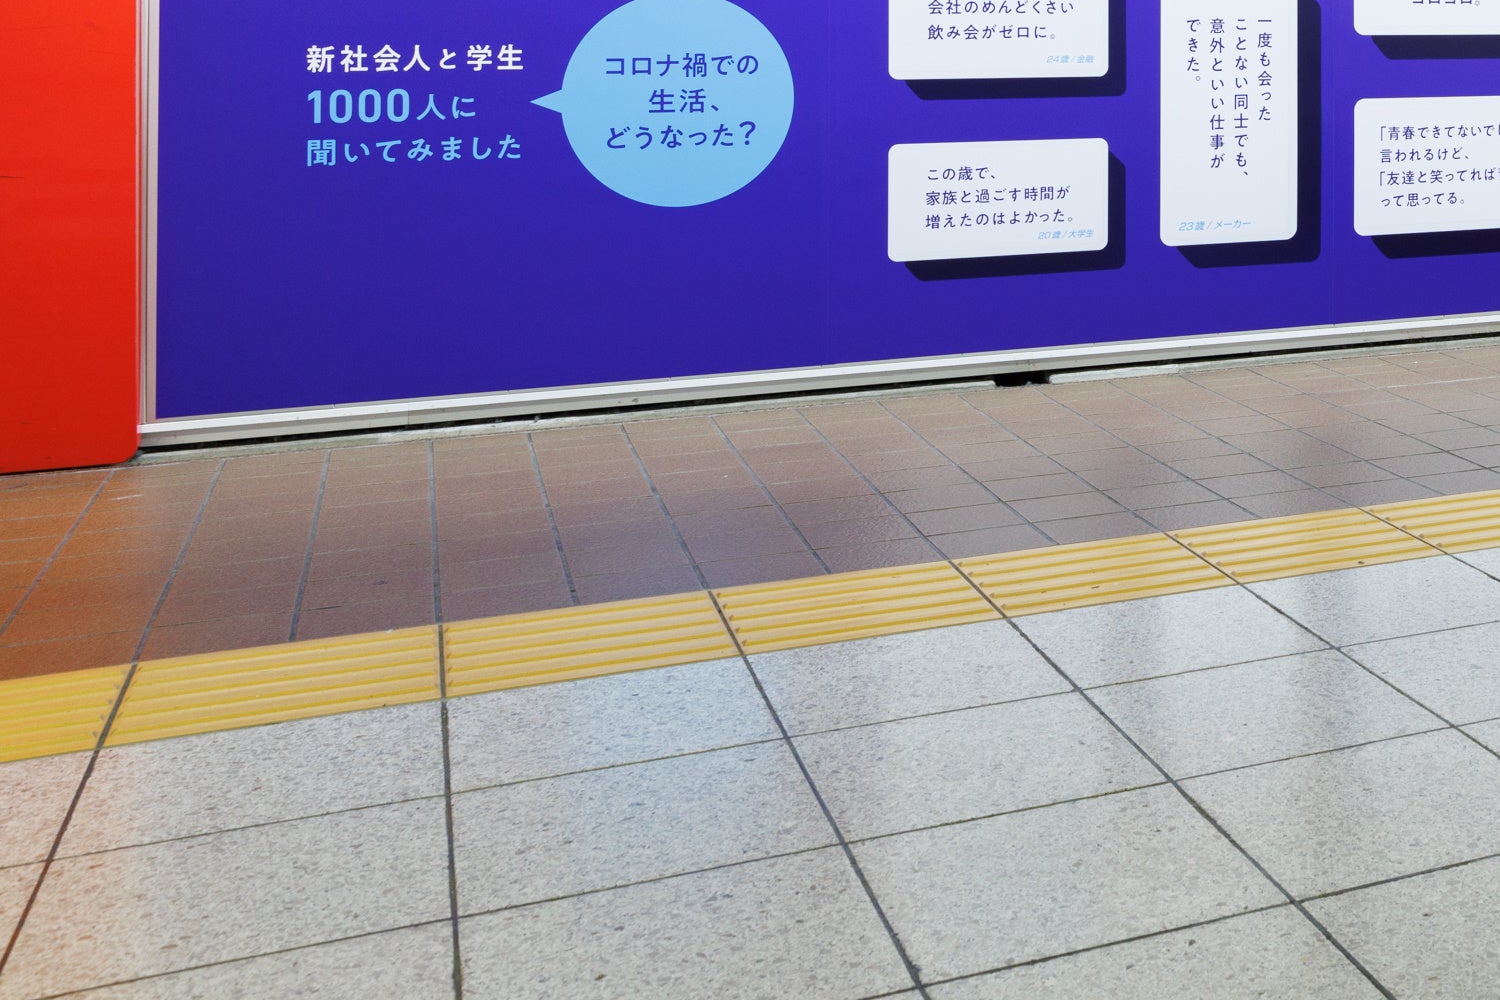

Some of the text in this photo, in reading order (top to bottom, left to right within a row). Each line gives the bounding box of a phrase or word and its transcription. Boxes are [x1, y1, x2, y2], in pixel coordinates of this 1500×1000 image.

[926, 23, 1058, 42] 飲み会がゼロに。
[305, 44, 524, 74] 新社会人と学生
[1185, 17, 1203, 83] できた。
[604, 52, 760, 79] コロナ禍での
[1256, 18, 1273, 122] 一度も会った
[305, 88, 478, 125] 1000人に
[648, 87, 721, 115] 生活、
[1209, 17, 1226, 170] 意外といい仕事が
[1233, 17, 1250, 178] ことない同士でも、
[605, 120, 758, 151] どうなった？
[305, 133, 523, 168] 聞いてみました
[1380, 146, 1472, 164] 言われるけど、
[926, 165, 997, 182] この歳で、
[925, 184, 1072, 207] 家族と過ごす時間が
[1380, 191, 1466, 208] って思ってる。
[924, 208, 1075, 230] 増えたのはよかった。
